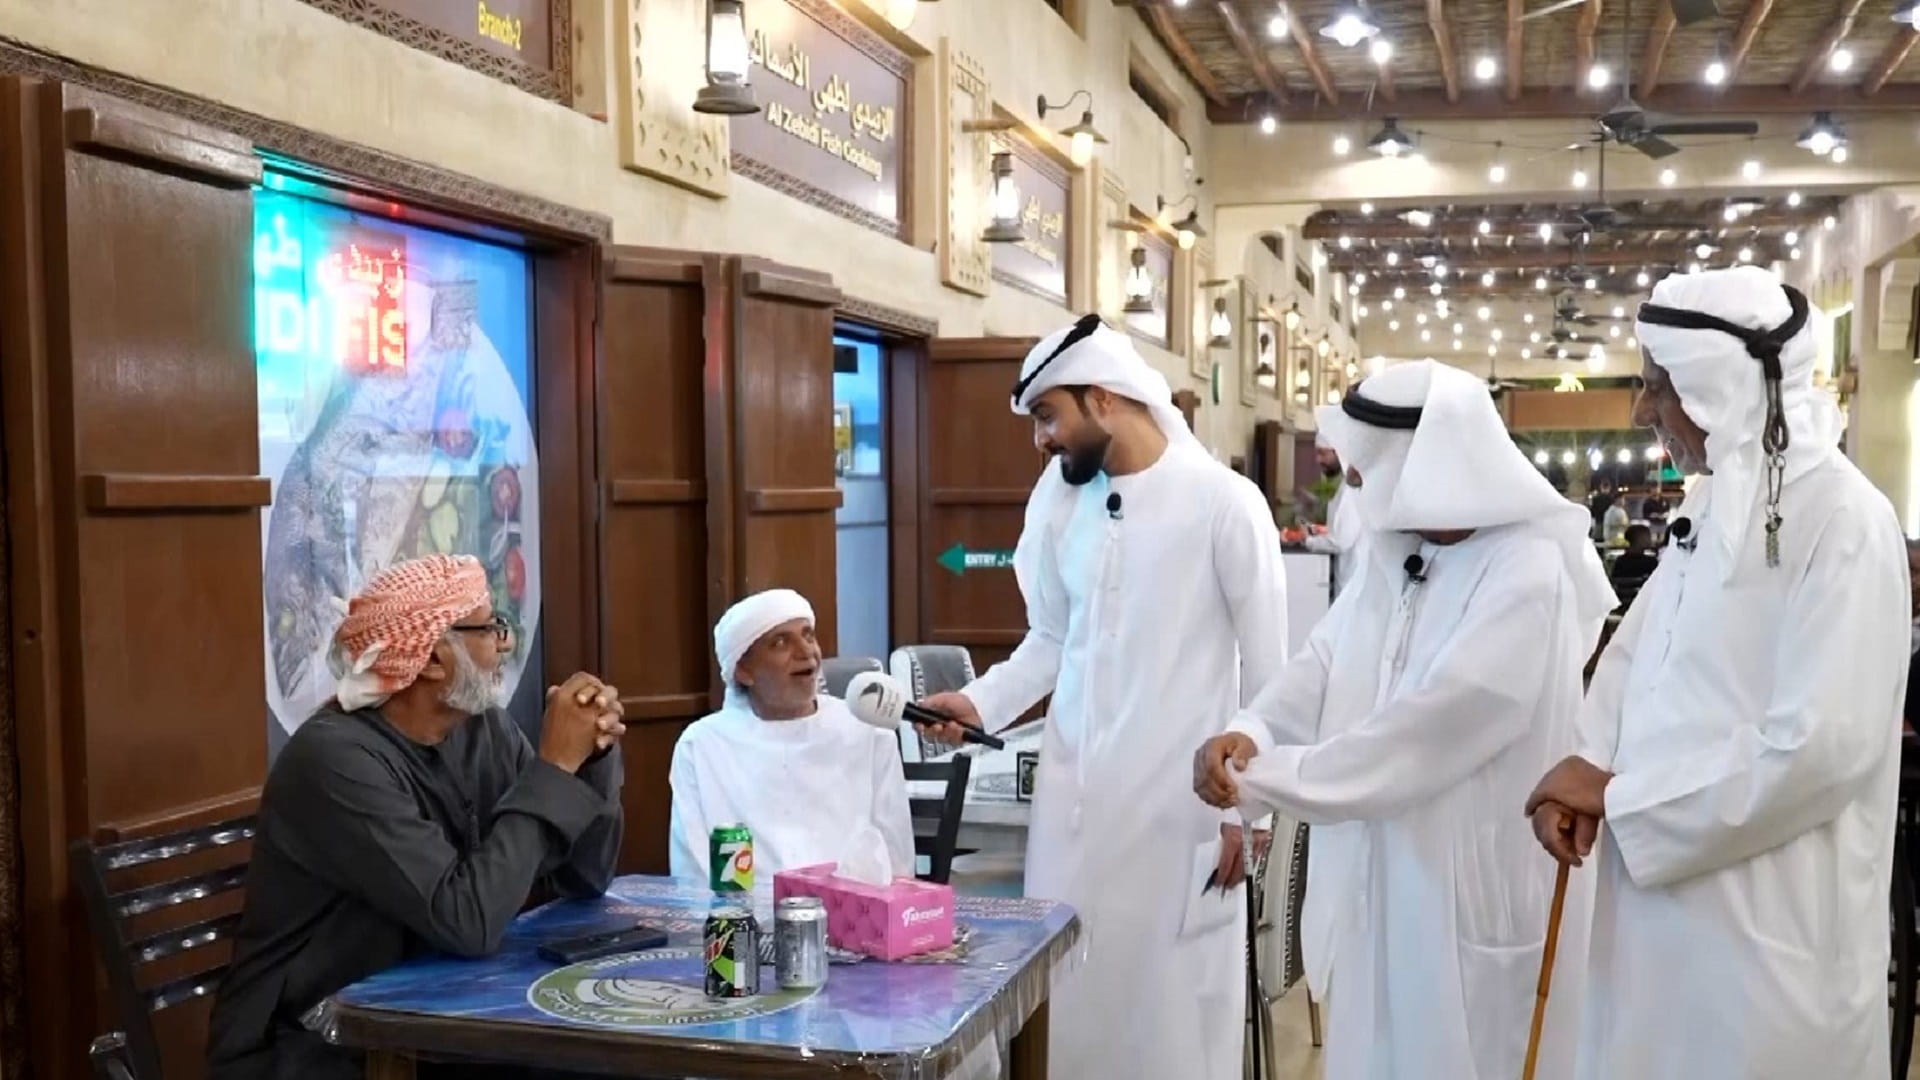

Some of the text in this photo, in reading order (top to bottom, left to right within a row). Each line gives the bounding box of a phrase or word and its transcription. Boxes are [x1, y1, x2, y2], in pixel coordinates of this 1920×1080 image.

[478, 1, 521, 50] Branch-2
[767, 102, 782, 127] Al
[820, 127, 842, 157] Fish
[842, 140, 882, 182] Cooking
[964, 552, 997, 568] ENTRY
